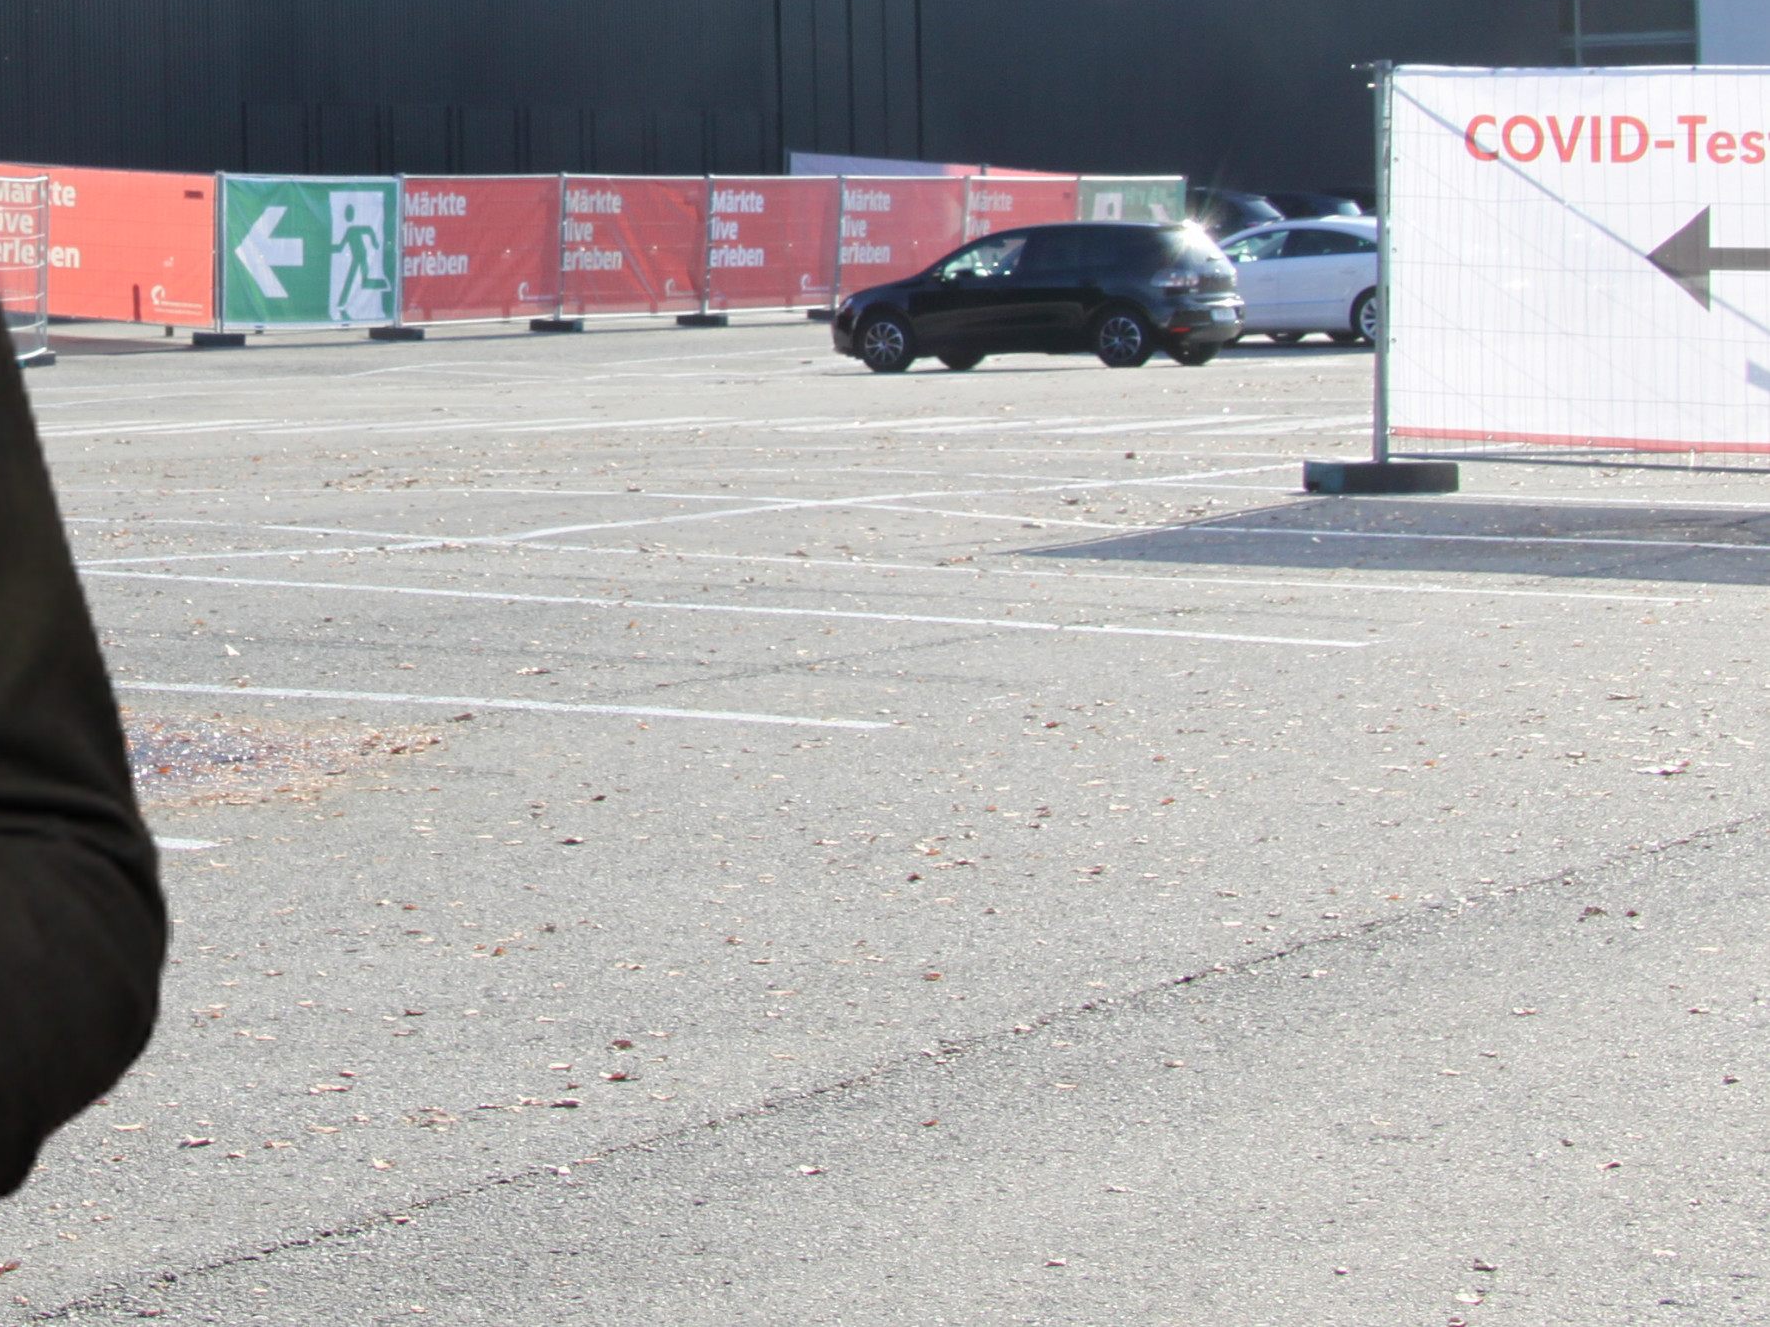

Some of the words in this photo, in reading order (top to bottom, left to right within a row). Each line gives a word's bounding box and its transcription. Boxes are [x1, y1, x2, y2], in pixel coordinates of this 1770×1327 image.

[1464, 114, 1770, 164] COVID-Tes
[404, 191, 467, 216] Märkte
[565, 189, 622, 213] Märkte
[711, 190, 765, 213] Märkte
[402, 222, 436, 246] live
[563, 218, 593, 241] live
[711, 217, 739, 240] live
[402, 246, 469, 276] erleben
[563, 246, 623, 271] erleben
[710, 244, 765, 267] erleben
